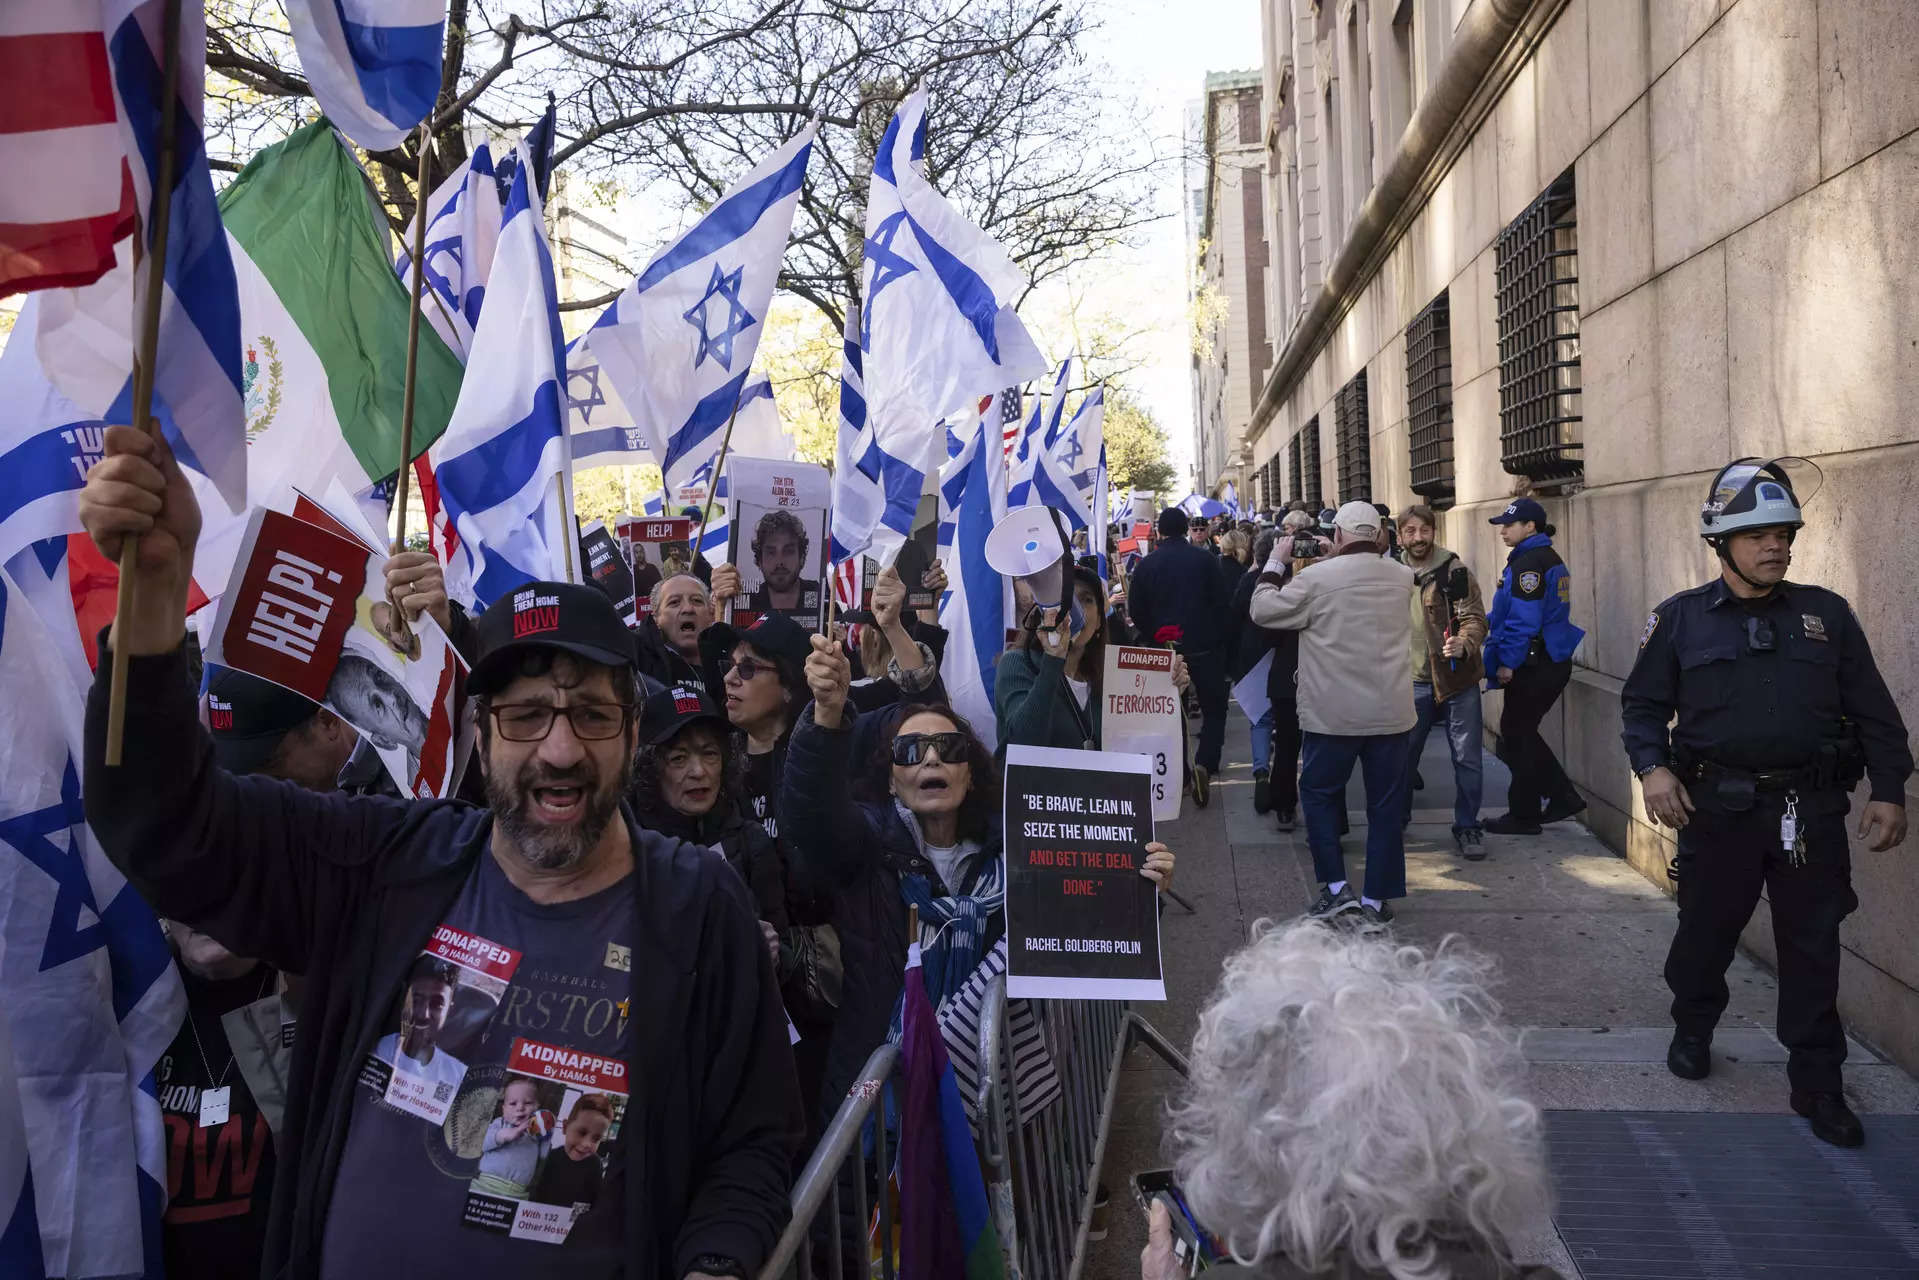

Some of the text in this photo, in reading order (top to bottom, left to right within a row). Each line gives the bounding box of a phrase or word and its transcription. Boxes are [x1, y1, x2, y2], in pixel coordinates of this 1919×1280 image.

[647, 524, 673, 538] HELP!
[513, 589, 535, 604] BRING
[513, 595, 560, 613] THEM HOME
[734, 594, 751, 610] HIM
[246, 549, 343, 664] HELP!
[513, 607, 560, 635] NOW
[1120, 652, 1169, 666] KIDNAPPED
[1108, 694, 1175, 715] TERRORISTS
[1022, 794, 1136, 817] "BE BRAVE, LEAN IN,
[1023, 822, 1137, 844] SEIZE THE MOMENT,
[1029, 850, 1135, 869] AND GET THE DEAL
[1063, 879, 1103, 896] DONE."
[1025, 937, 1141, 954] RACHEL GOLDBERG POLIN
[438, 944, 480, 967] By HAMAS
[521, 1043, 625, 1077] KIDNAPPED
[543, 1065, 597, 1084] By HAMAS
[409, 1096, 443, 1116] Hostages
[522, 1209, 559, 1223] With 132
[518, 1221, 543, 1232] Other
[543, 1225, 569, 1235] Hosta
